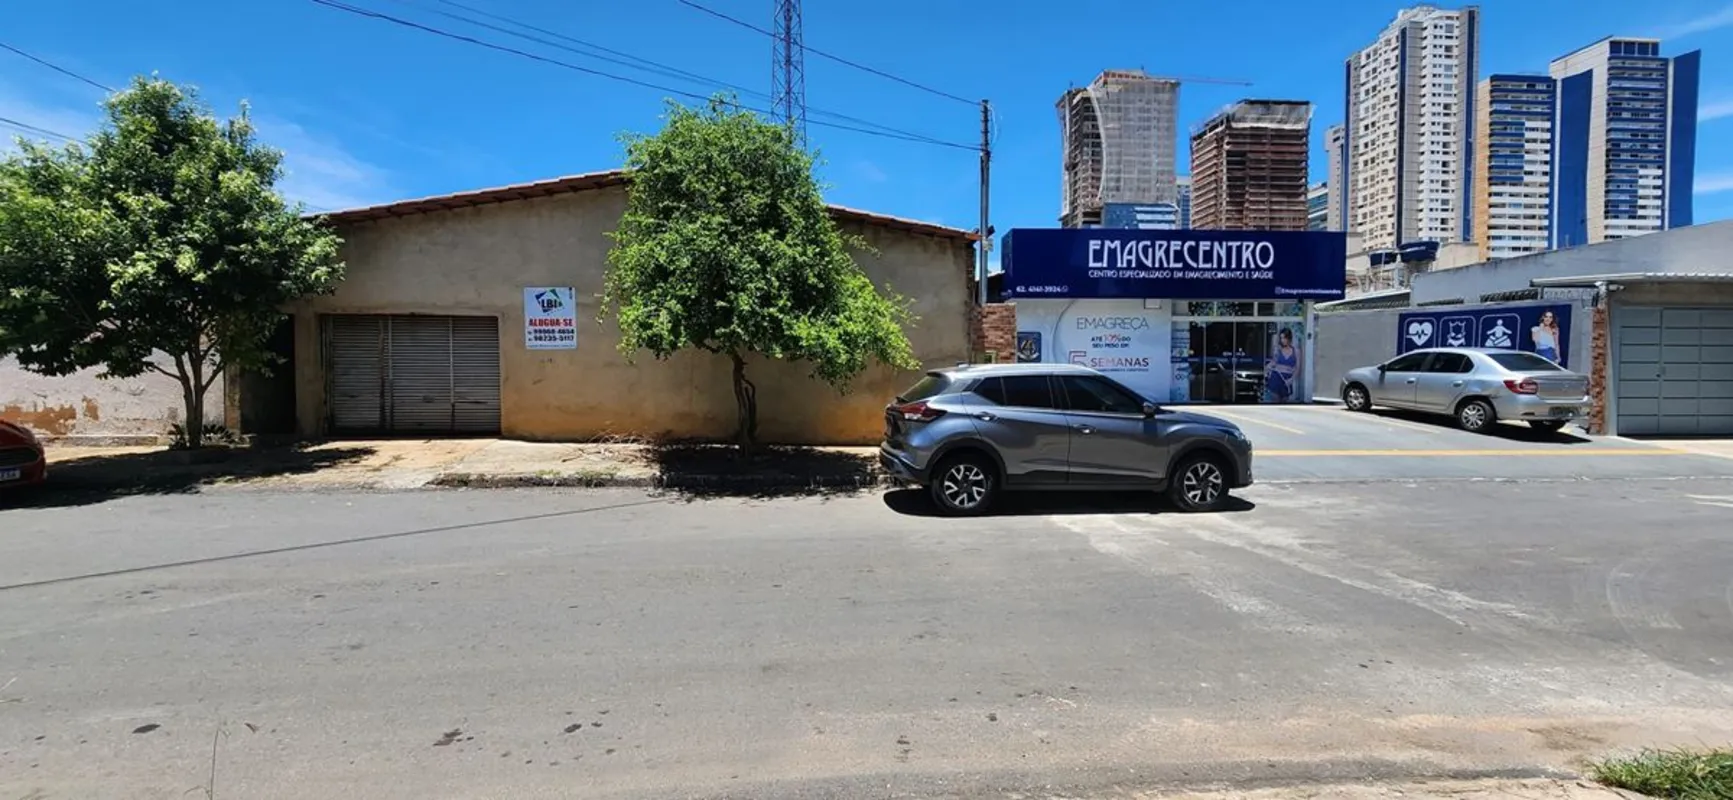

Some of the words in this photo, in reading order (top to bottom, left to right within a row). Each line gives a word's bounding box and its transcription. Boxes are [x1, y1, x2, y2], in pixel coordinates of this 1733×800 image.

[1088, 240, 1275, 269] EMAGRECENTRO
[1088, 270, 1117, 278] CENTRO
[1119, 270, 1171, 278] ESPECIALIZADO
[1173, 270, 1183, 279] EM
[1185, 270, 1244, 279] EMAGRECIMENTO
[1245, 271, 1250, 279] E
[1251, 270, 1274, 279] SAÚDE
[528, 318, 573, 327] ALUGUA-SE
[1076, 317, 1149, 331] EMAGREÇA
[1090, 357, 1149, 367] SEMANAS
